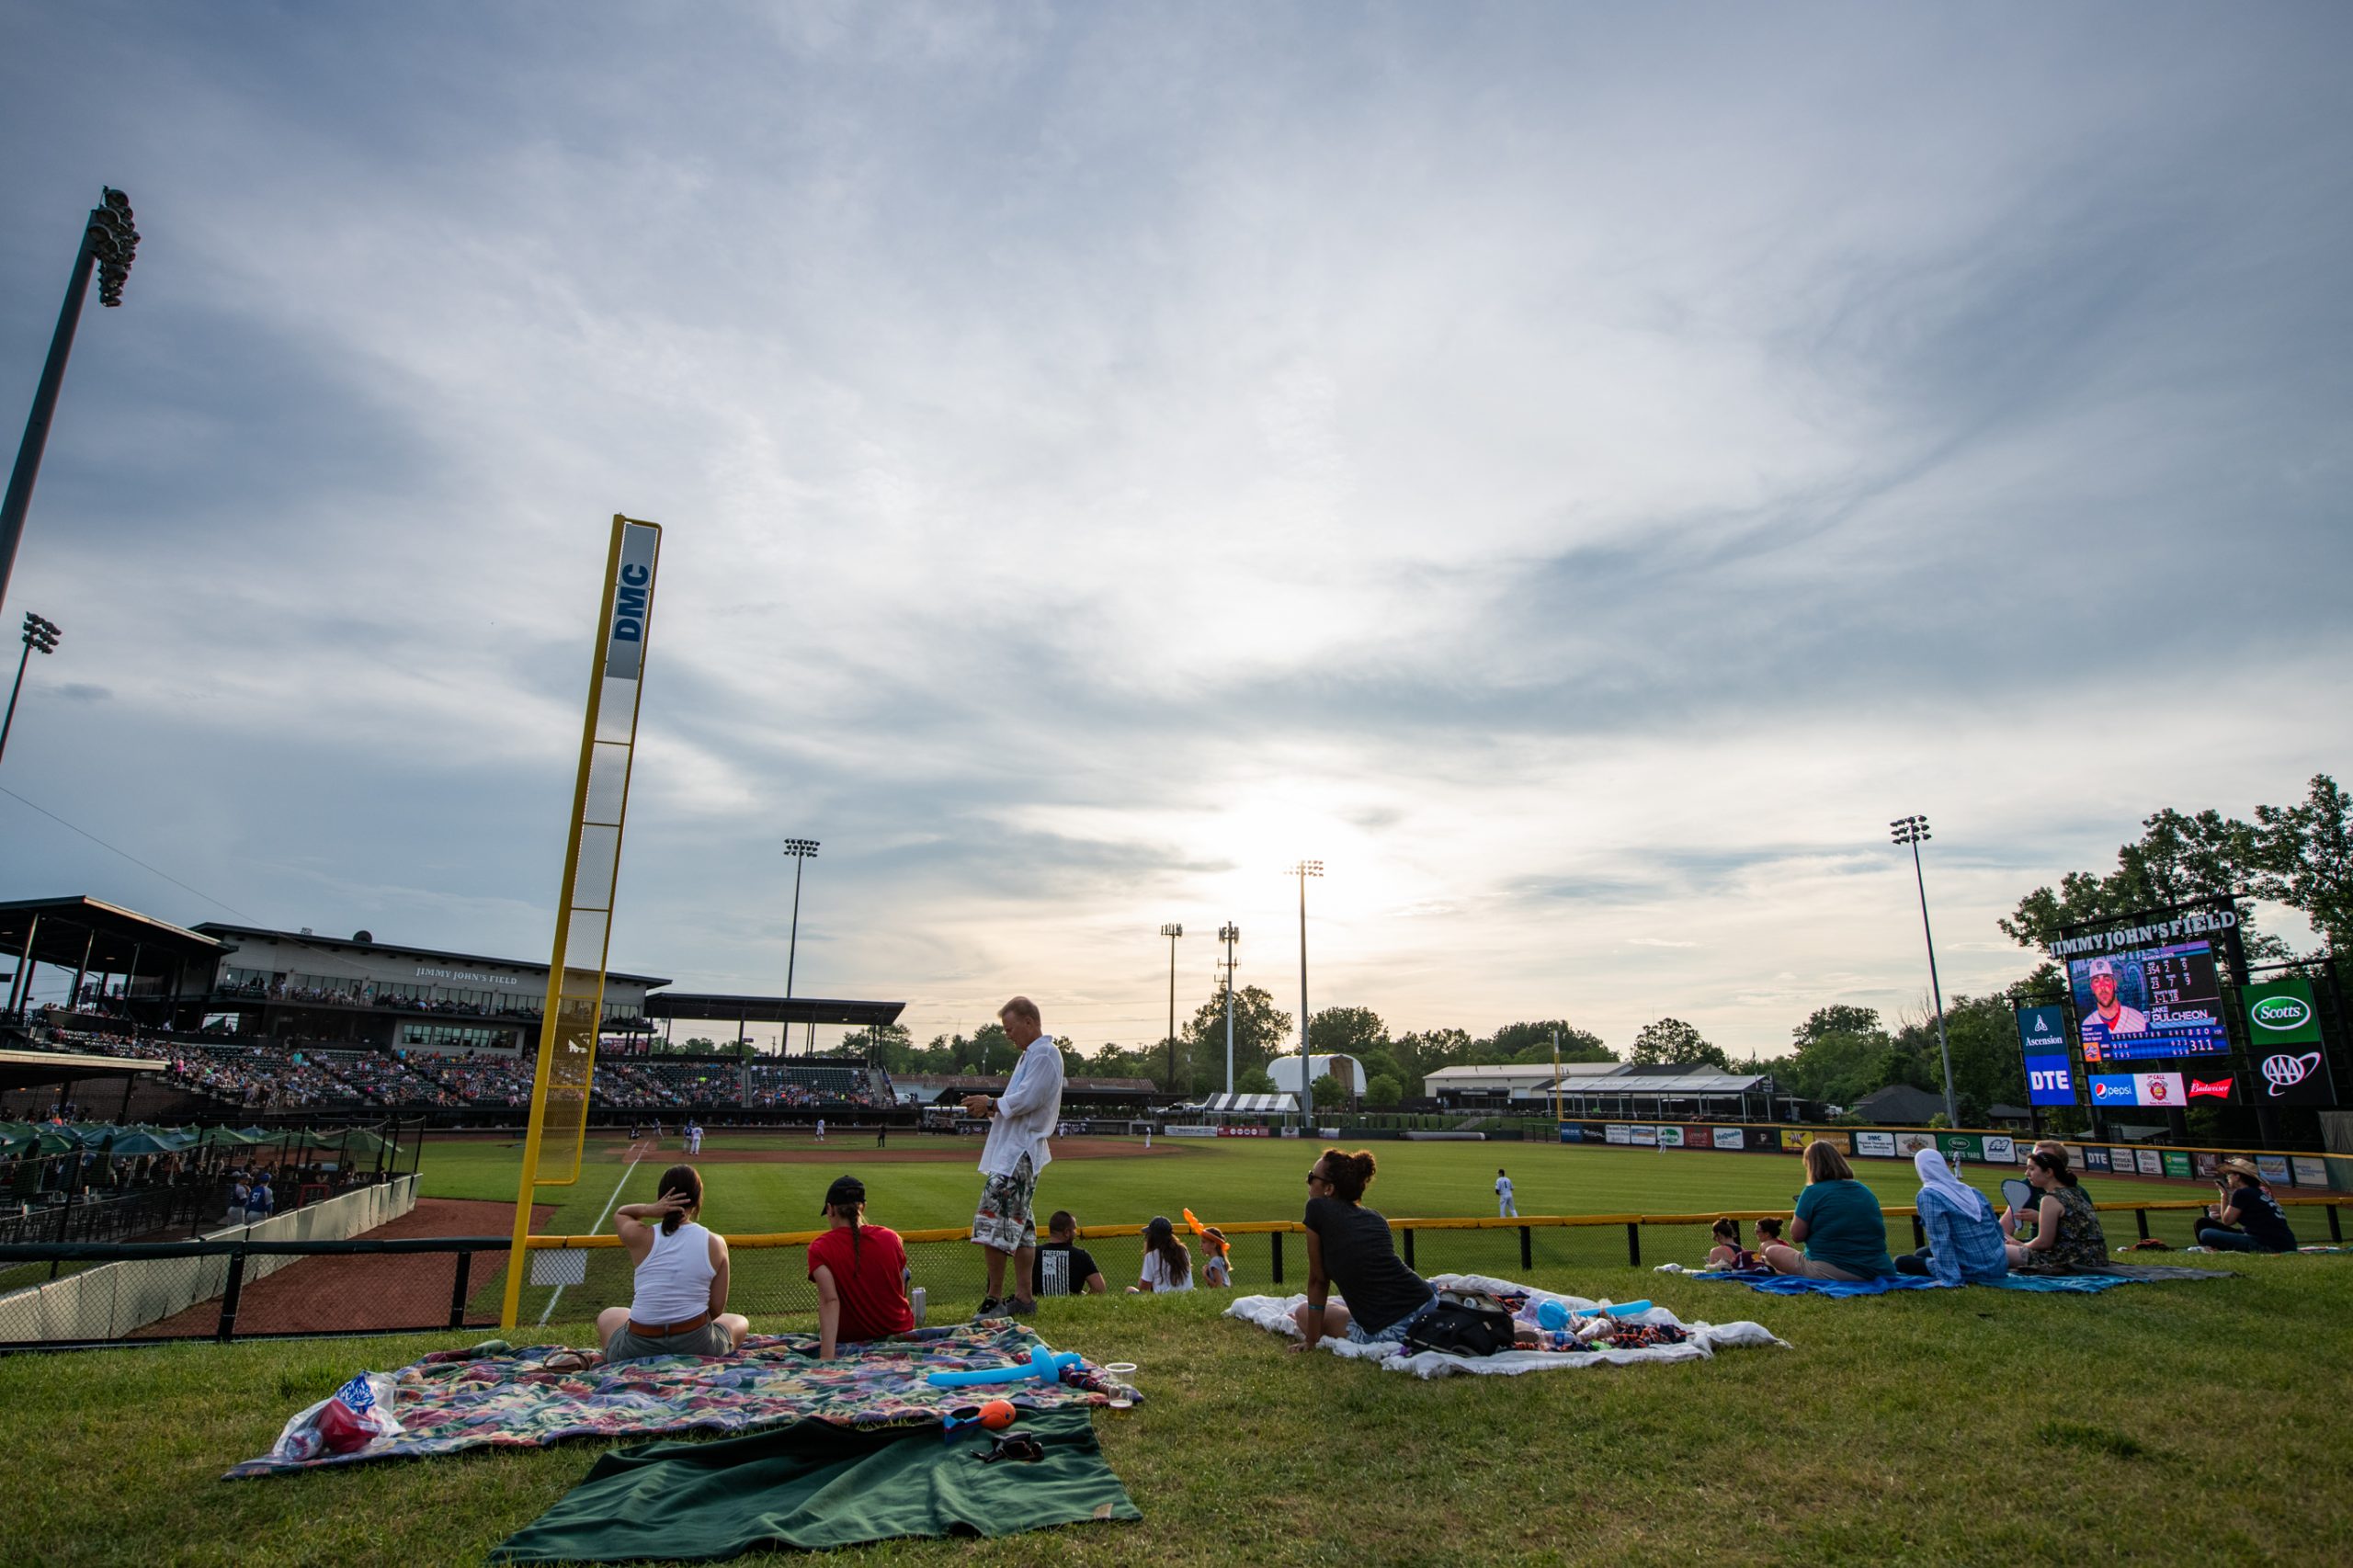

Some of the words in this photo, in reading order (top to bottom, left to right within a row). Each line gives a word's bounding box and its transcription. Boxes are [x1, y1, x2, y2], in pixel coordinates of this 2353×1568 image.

[614, 563, 649, 642] DMC
[2049, 934, 2104, 959] JIMMY
[2105, 923, 2170, 951] JOHN'S
[2170, 911, 2236, 935] FIELD
[2181, 961, 2188, 971] 9
[416, 967, 451, 979] JIMMY
[453, 971, 487, 983] JOHN'S
[489, 975, 517, 985] FIELD
[2152, 1009, 2208, 1023] PULCHEON
[2260, 1006, 2301, 1019] Scotts
[2026, 1035, 2063, 1046] Ascension
[2268, 1056, 2301, 1084] AAA
[2029, 1070, 2070, 1090] DTE
[2108, 1085, 2132, 1096] pepsi
[2191, 1082, 2229, 1093] Budweiser
[2087, 1153, 2108, 1165] DTE
